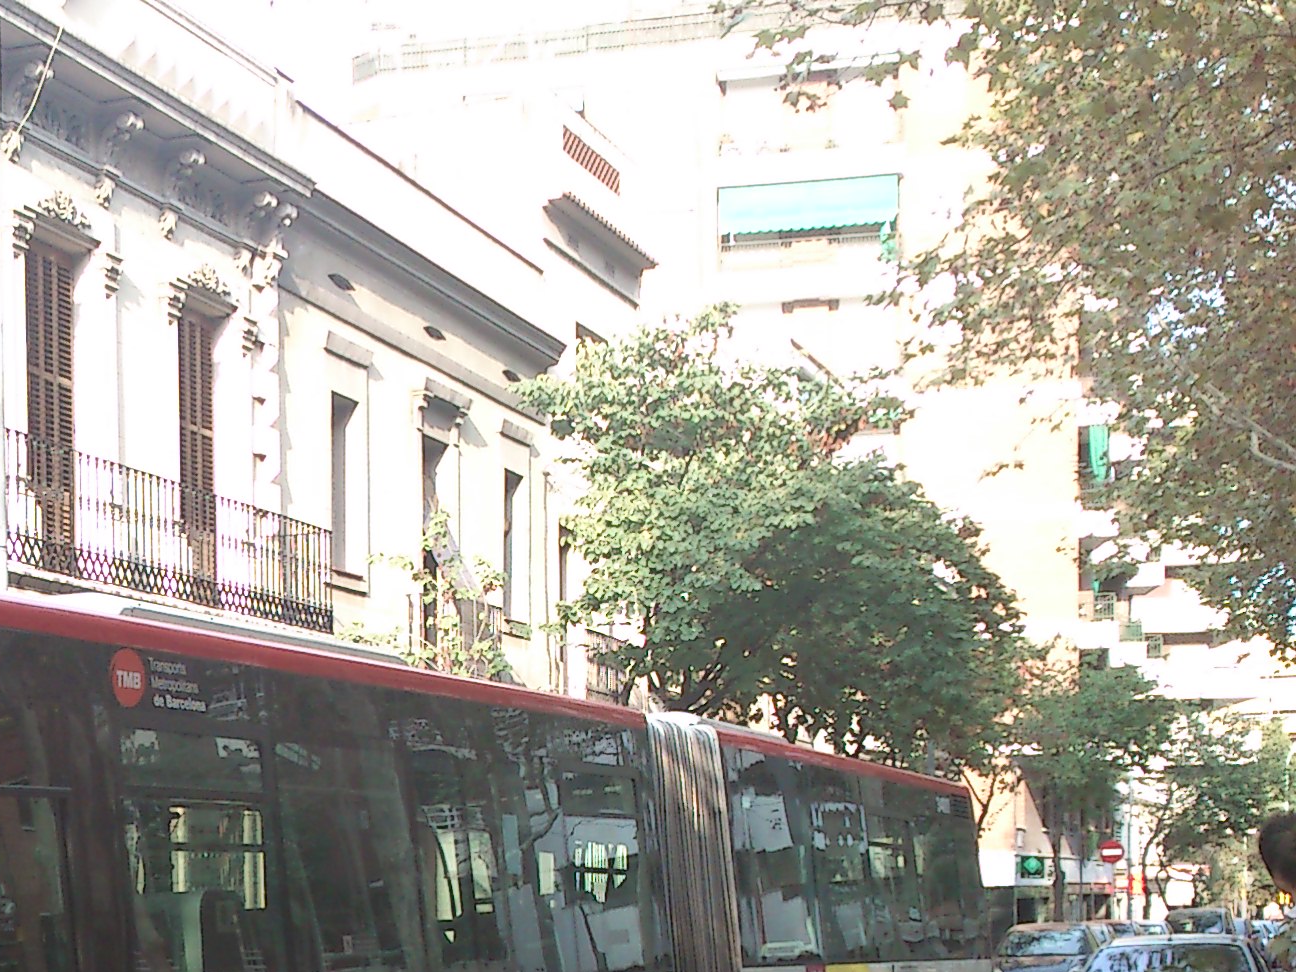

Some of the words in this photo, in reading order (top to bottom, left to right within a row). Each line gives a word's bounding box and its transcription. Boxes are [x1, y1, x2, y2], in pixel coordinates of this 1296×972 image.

[116, 668, 142, 690] TMB
[153, 693, 164, 708] de
[165, 694, 207, 712] Barcelona
